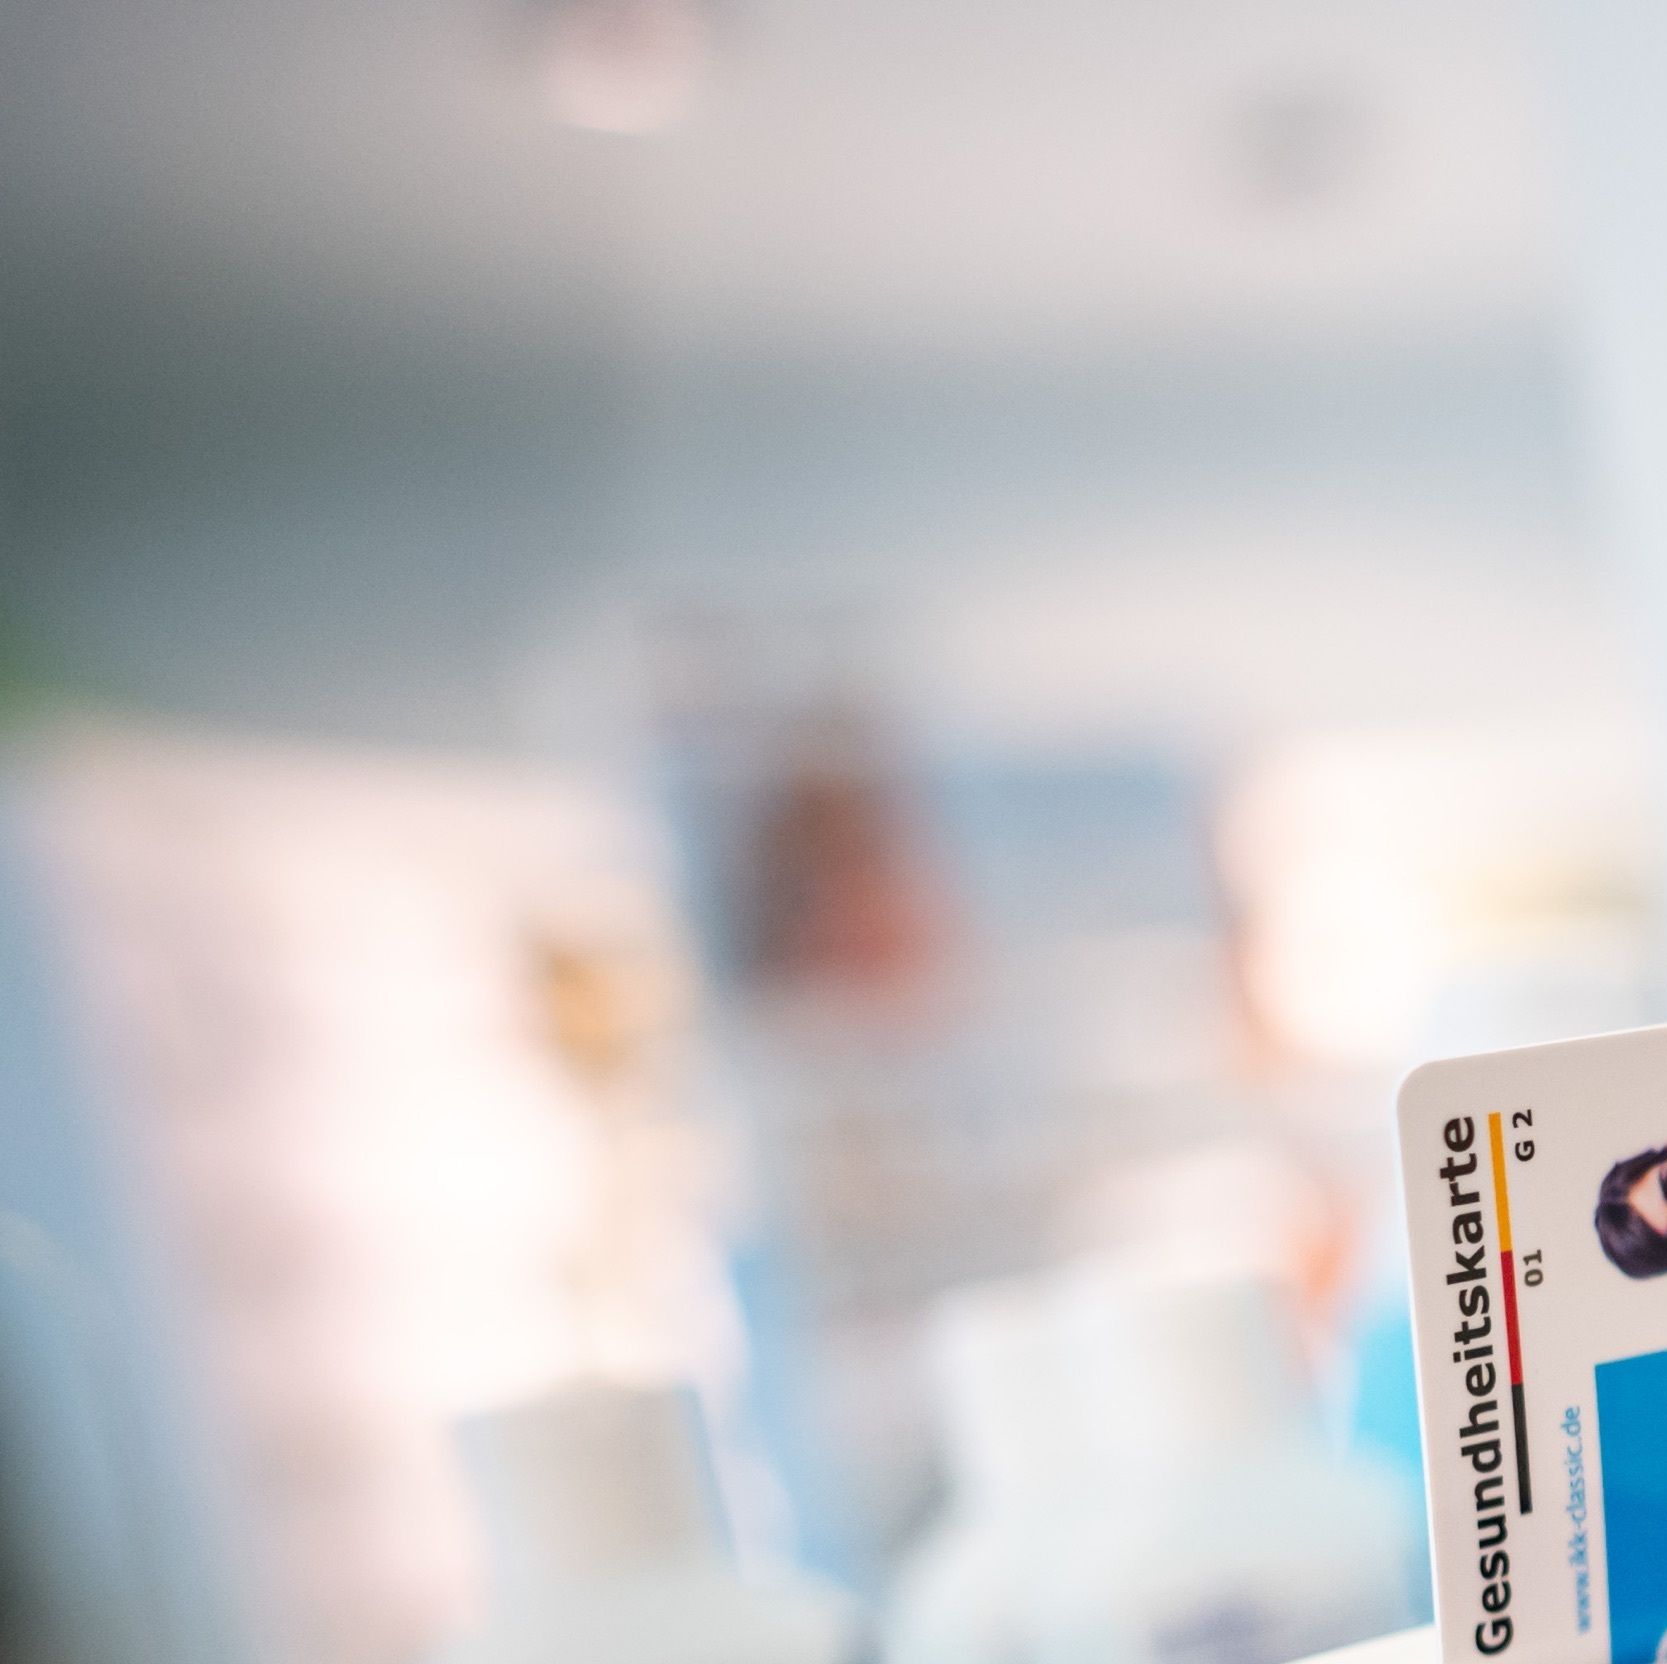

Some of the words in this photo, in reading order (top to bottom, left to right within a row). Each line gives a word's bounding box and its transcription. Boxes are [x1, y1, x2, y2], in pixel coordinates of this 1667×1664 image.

[1512, 1109, 1533, 1128] 2
[1514, 1139, 1536, 1162] G
[1523, 1249, 1544, 1287] 01
[1439, 1116, 1514, 1655] Gesundheitskarte
